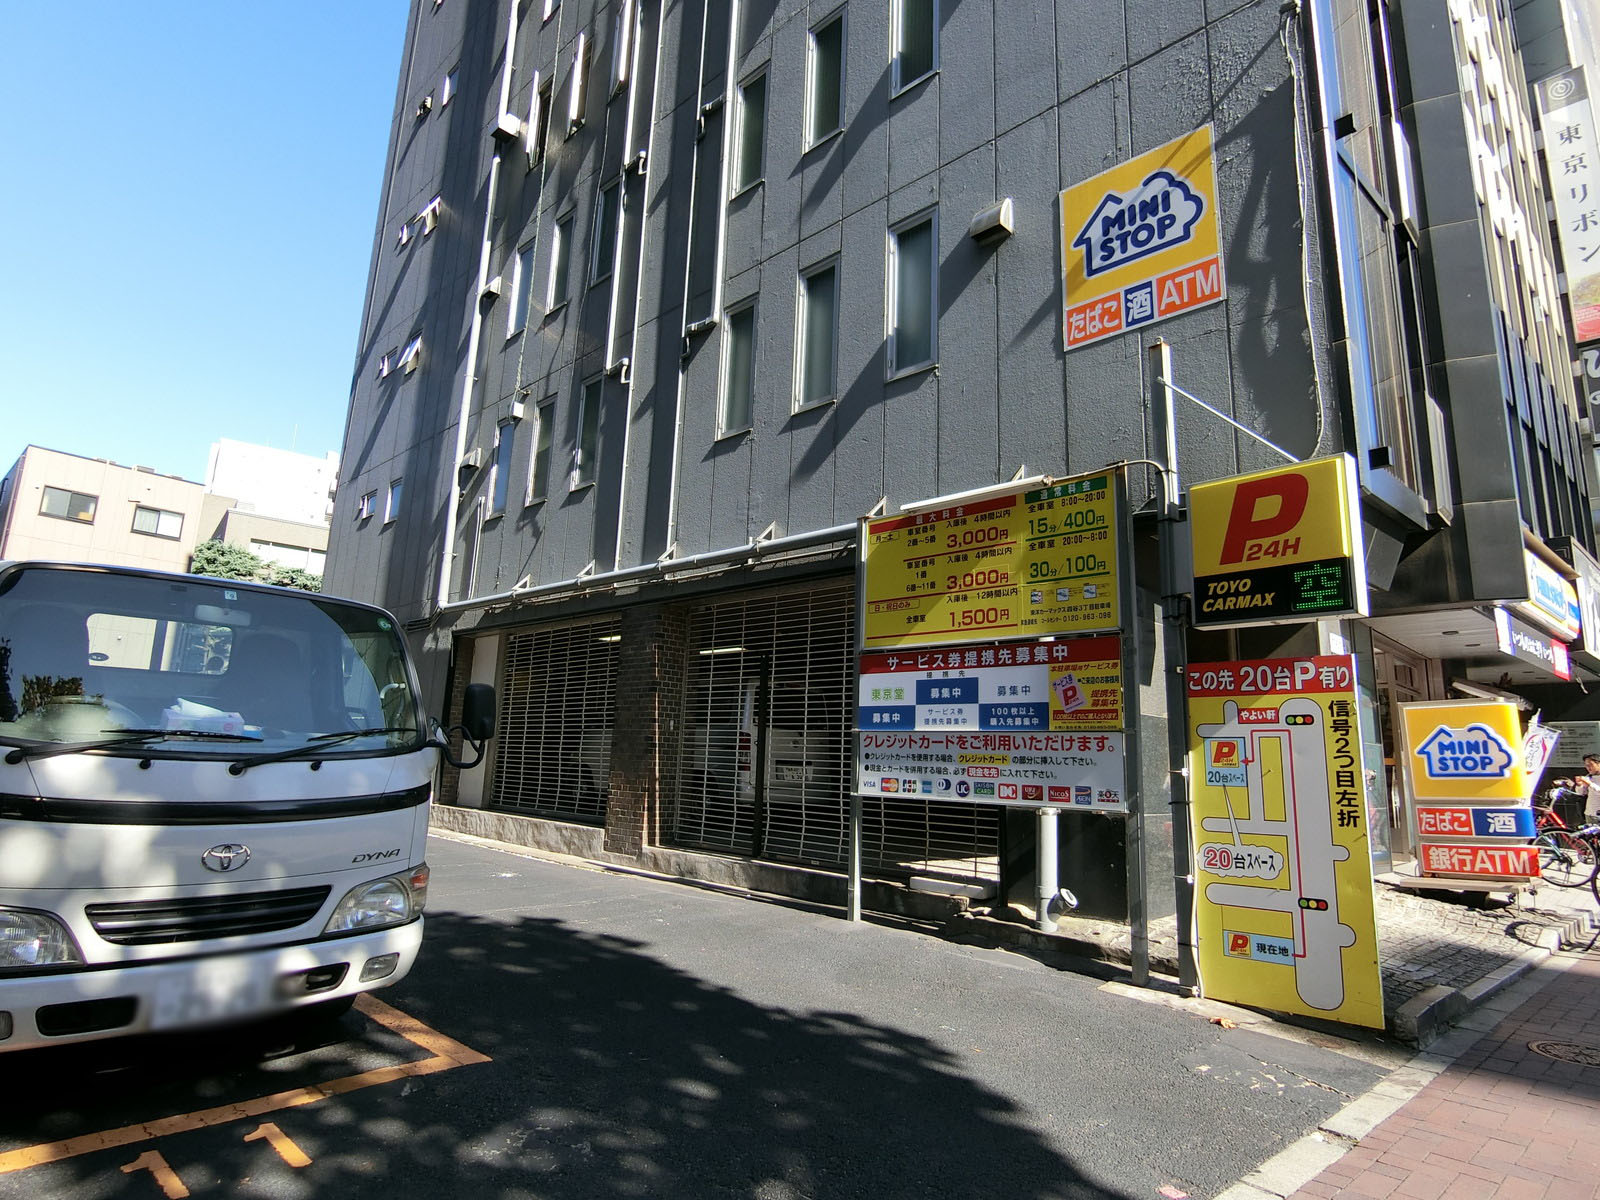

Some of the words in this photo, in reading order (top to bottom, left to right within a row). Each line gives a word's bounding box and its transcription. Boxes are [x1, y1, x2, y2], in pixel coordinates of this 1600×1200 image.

[1556, 123, 1600, 263] 東京リボン
[1101, 190, 1170, 238] MINI
[1099, 213, 1176, 262] STOP
[1069, 300, 1120, 342] たばこ
[1126, 287, 1152, 324] 酒
[1160, 264, 1219, 311] ATM
[1040, 480, 1091, 500] 通常料金
[916, 507, 966, 524] 最大料金
[1028, 501, 1054, 513] 全車室
[946, 518, 967, 528] 入庫後
[974, 509, 1011, 523] 4時間以内
[1219, 473, 1309, 566] P
[907, 524, 936, 536] 車室番号
[946, 526, 1009, 548] 3,000円
[1028, 539, 1055, 551] 全車室
[1246, 537, 1302, 562] 24H
[906, 558, 936, 569] 車室番号
[947, 553, 968, 564] 入庫後
[975, 547, 1013, 560] 4時間以内
[916, 571, 927, 579] 1番
[947, 569, 1009, 590] 3,000円
[1207, 578, 1252, 596] TOYO
[1294, 563, 1344, 609] 空
[946, 594, 968, 604] 入庫後
[976, 587, 1018, 600] 12時間以内
[1202, 592, 1276, 613] CARMAX
[906, 614, 926, 624] 全車室
[950, 607, 1010, 628] 1,500円
[887, 644, 1068, 671] サービス券提携先募集中
[926, 670, 966, 679] 提携先
[871, 687, 905, 701] 東京堂
[930, 687, 961, 699] 募集中
[997, 685, 1031, 697] 募集中
[1091, 689, 1119, 698] 提携先
[928, 708, 964, 716] サービス券
[1091, 699, 1119, 708] 募集中
[872, 712, 901, 724] 募集中
[924, 717, 968, 726] 提携先募集中
[989, 717, 1039, 726] 購入先募集中
[1240, 709, 1276, 721] やよい軒
[863, 734, 1115, 752] クレジットカードをご利用いただけます。
[1437, 739, 1489, 755] MINI
[1213, 741, 1236, 764] P
[1328, 699, 1361, 828] 信号2つ目左折
[1438, 756, 1494, 771] STOP
[1207, 770, 1245, 783] 20台スペース
[956, 785, 970, 794] UC
[1420, 812, 1470, 833] たばこ
[1486, 812, 1516, 833] 酒
[351, 848, 401, 864] DYNA
[1203, 848, 1276, 872] 20台スペース
[1428, 847, 1531, 874] 銀行ATM
[1230, 934, 1249, 952] P
[1255, 942, 1289, 957] 現在地
